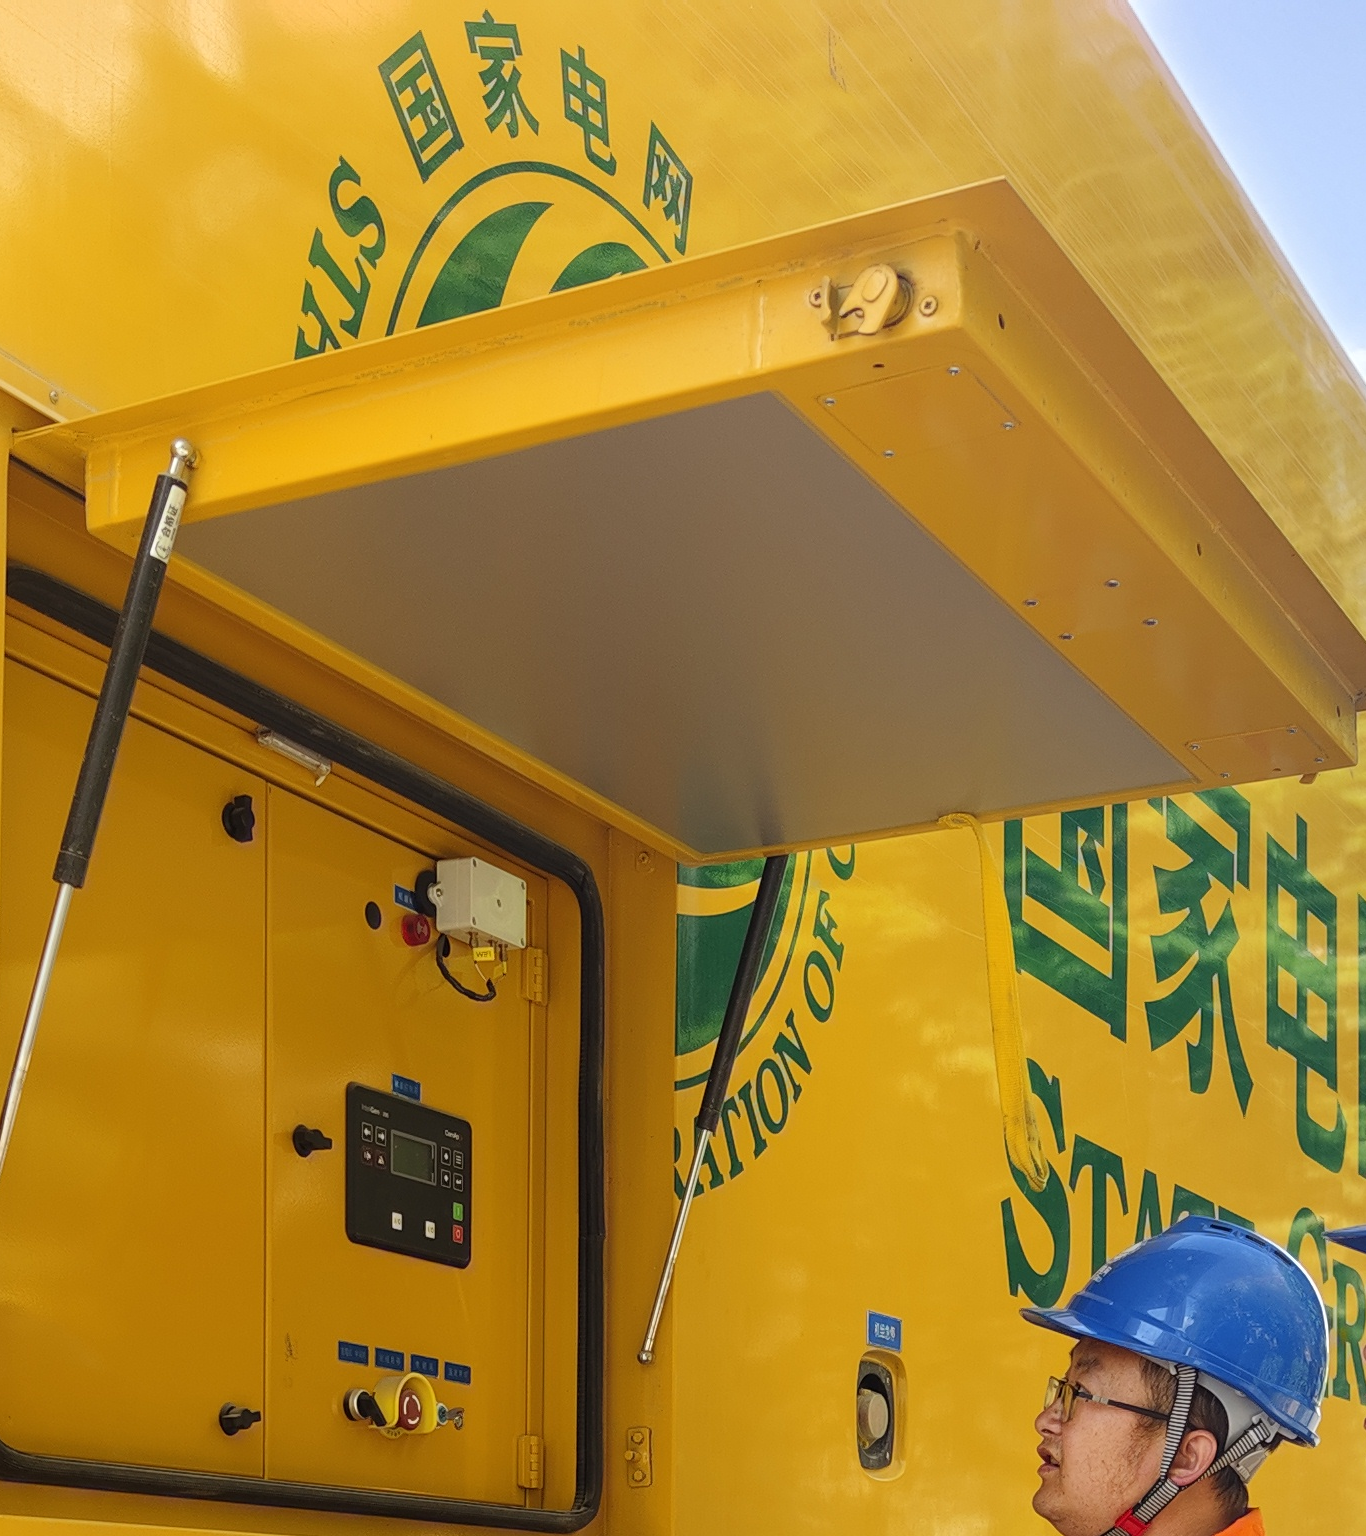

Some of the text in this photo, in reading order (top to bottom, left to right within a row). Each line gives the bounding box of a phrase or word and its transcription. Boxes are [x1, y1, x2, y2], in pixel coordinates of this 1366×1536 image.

[378, 8, 693, 256] 国家电网
[803, 889, 845, 1023] OF
